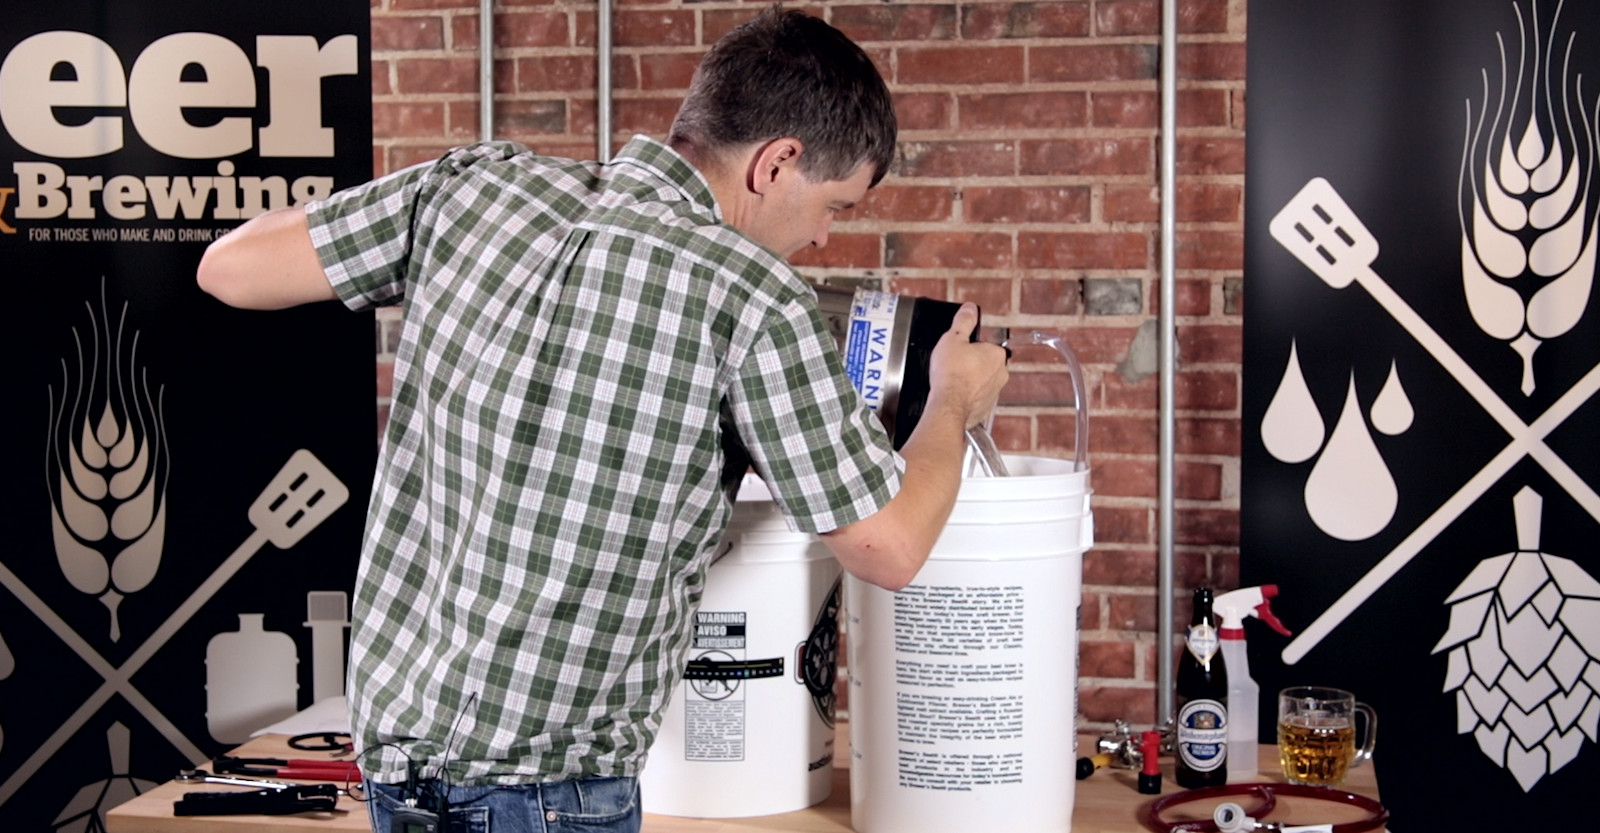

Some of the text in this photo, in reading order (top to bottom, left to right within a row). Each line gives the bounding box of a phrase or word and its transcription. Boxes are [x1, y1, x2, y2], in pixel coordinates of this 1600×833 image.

[29, 228, 51, 241] FOR
[53, 228, 90, 241] THOSE
[92, 228, 118, 241] WHO
[120, 228, 150, 242] MAKE
[152, 228, 176, 242] AND
[178, 228, 213, 242] DRINK
[864, 328, 887, 410] WARNI
[697, 613, 745, 623] WARNING
[697, 625, 727, 636] AVISO
